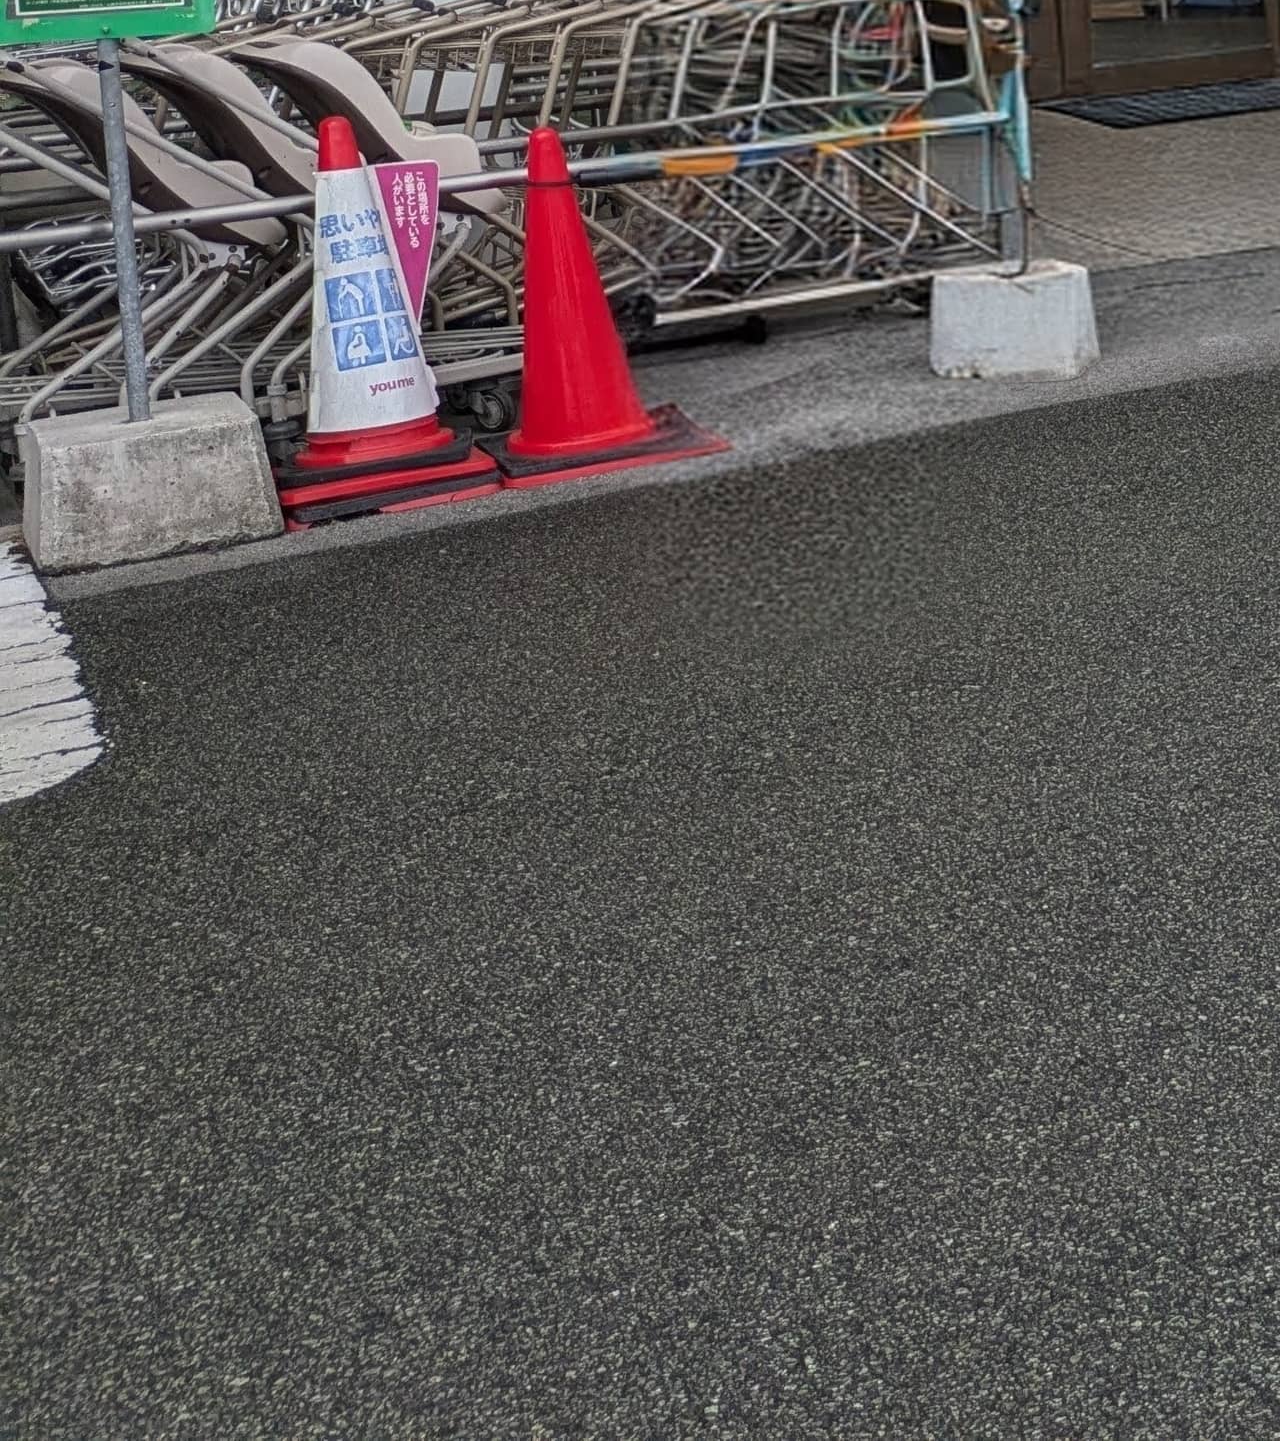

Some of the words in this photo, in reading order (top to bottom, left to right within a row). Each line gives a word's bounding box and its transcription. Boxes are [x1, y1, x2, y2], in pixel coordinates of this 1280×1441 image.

[391, 174, 406, 229] 人がいます
[403, 170, 421, 248] 必要としている
[415, 170, 431, 226] この場所を
